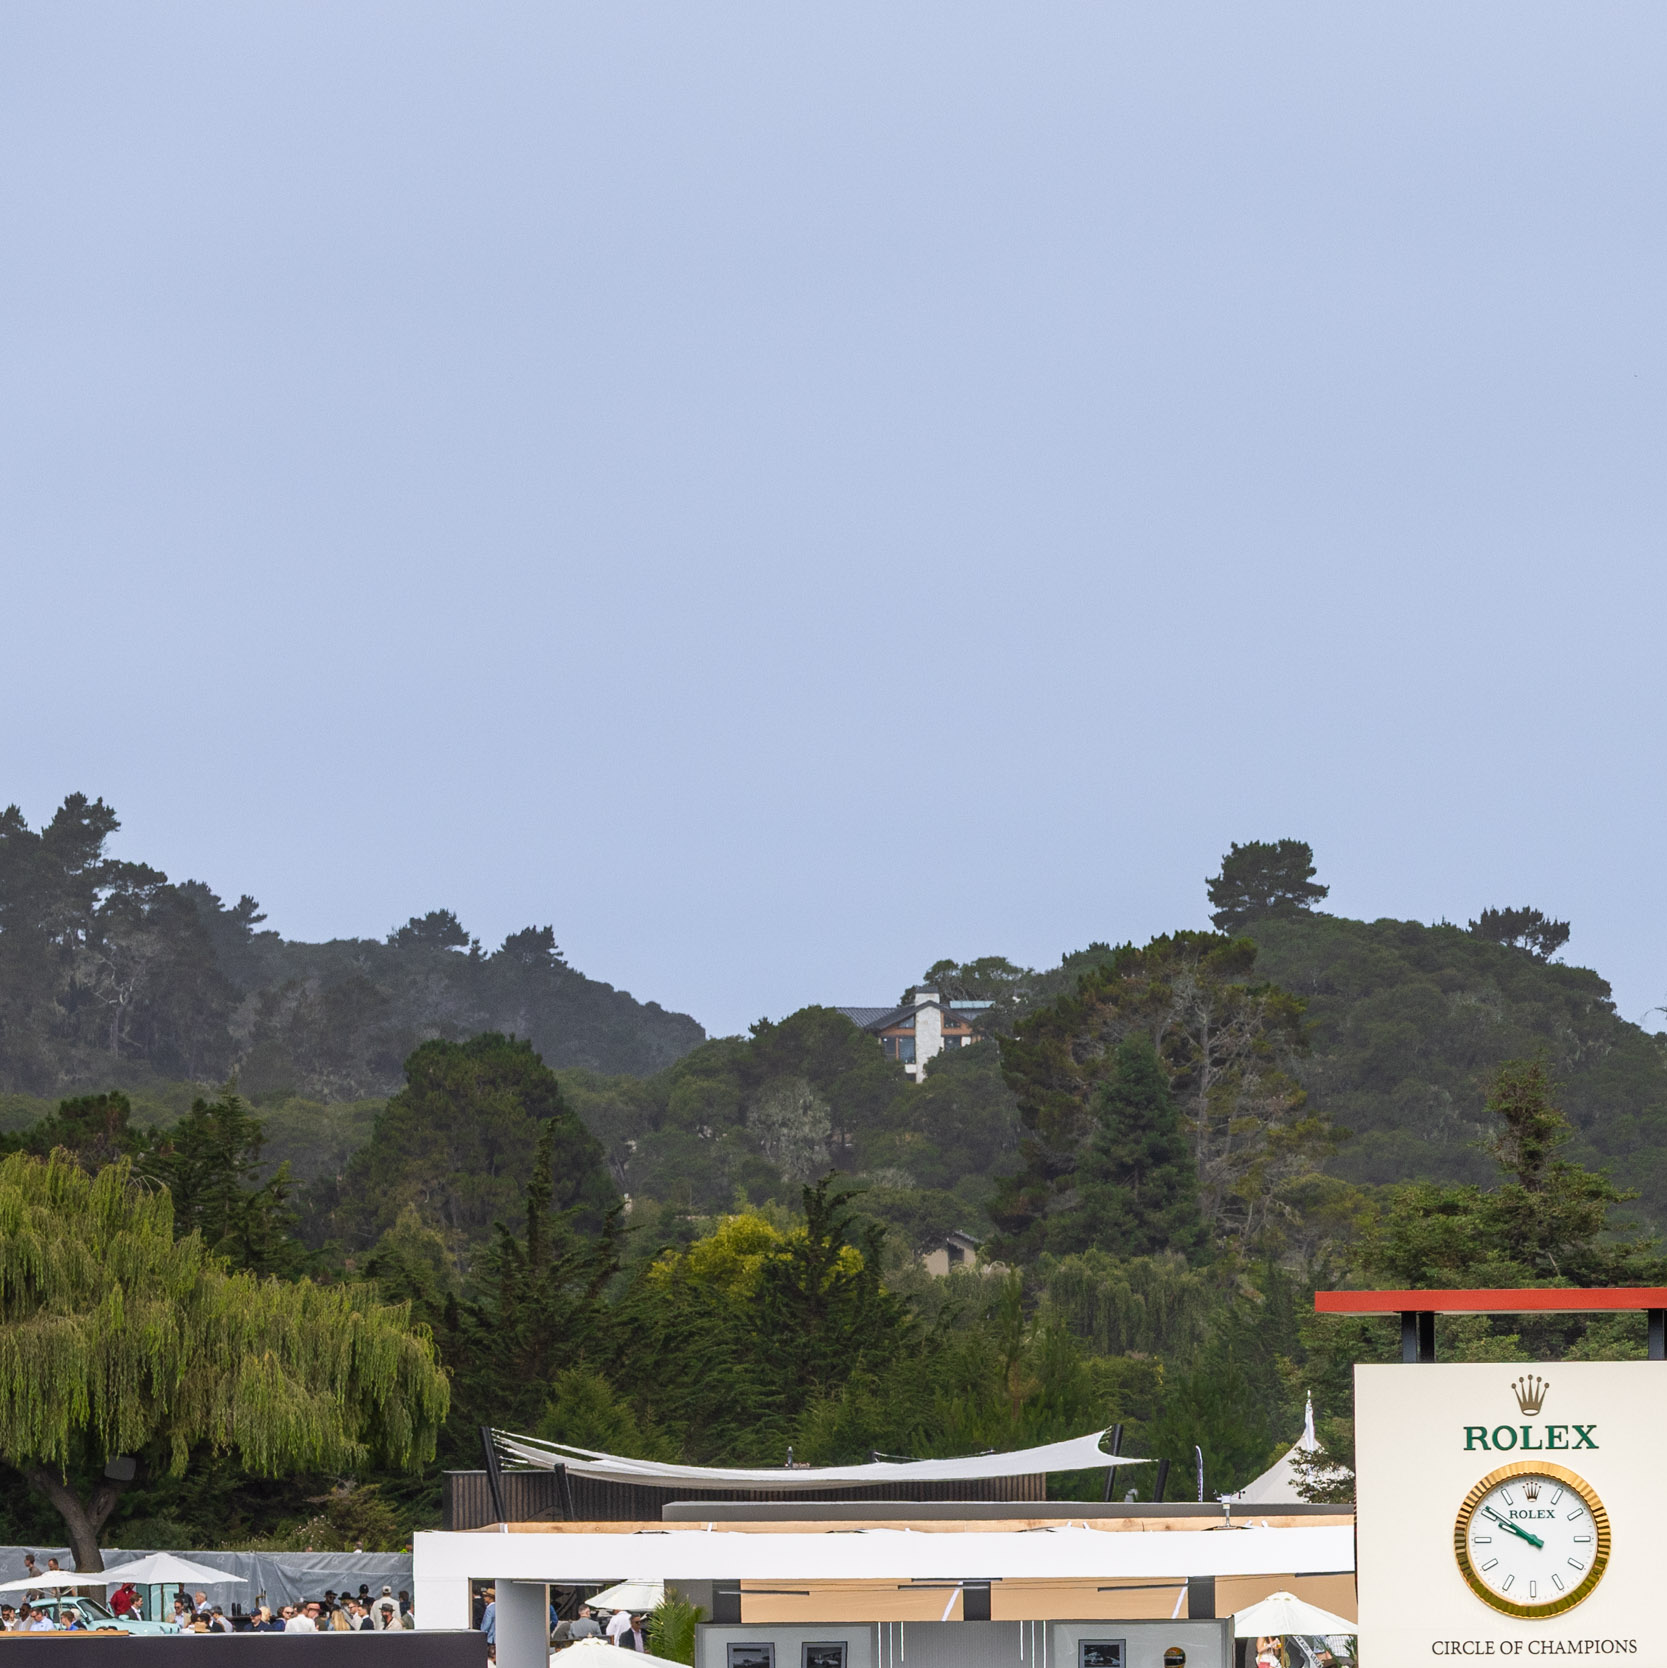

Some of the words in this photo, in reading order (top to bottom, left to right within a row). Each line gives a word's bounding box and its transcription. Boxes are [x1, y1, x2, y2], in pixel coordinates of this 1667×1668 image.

[1463, 1424, 1600, 1451] ROLEX
[1509, 1509, 1556, 1519] ROLEX
[1431, 1640, 1496, 1655] CIRCLE
[1499, 1640, 1524, 1655] OF
[1527, 1639, 1638, 1655] CHAMPIONS
